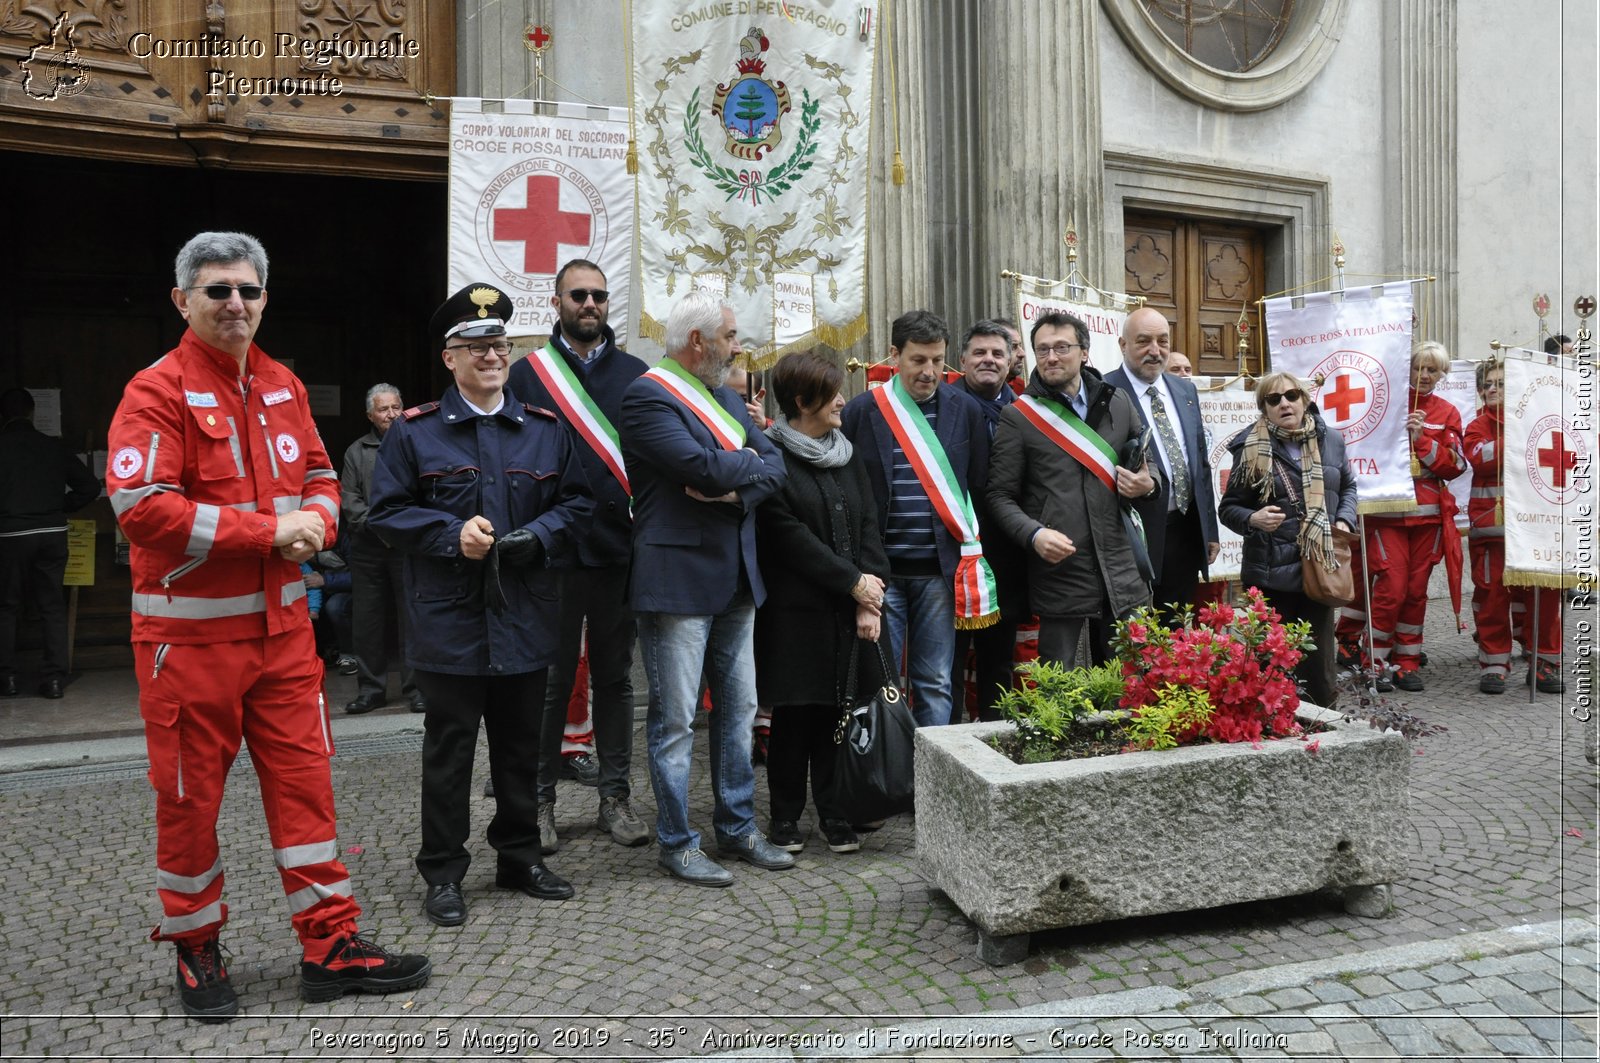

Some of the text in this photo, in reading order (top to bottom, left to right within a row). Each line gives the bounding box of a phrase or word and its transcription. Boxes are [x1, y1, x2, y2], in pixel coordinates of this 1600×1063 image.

[671, 1, 847, 37] COMUNE DI PEVERAGNO
[453, 139, 507, 154] CROCE
[512, 140, 563, 156] ROSSA
[462, 124, 625, 145] CORPO VOLONTARI DEL SOCCORSO
[481, 159, 604, 216] CONVENZIONE DI GINEVRA
[1281, 323, 1405, 348] CROCE ROSSA ITALIANA
[1327, 354, 1369, 372] GINEVRA
[1369, 367, 1383, 382] 22
[1368, 381, 1386, 425] AGOSTO
[1515, 382, 1537, 419] CROCE
[1527, 428, 1543, 490] CONVENZIONE
